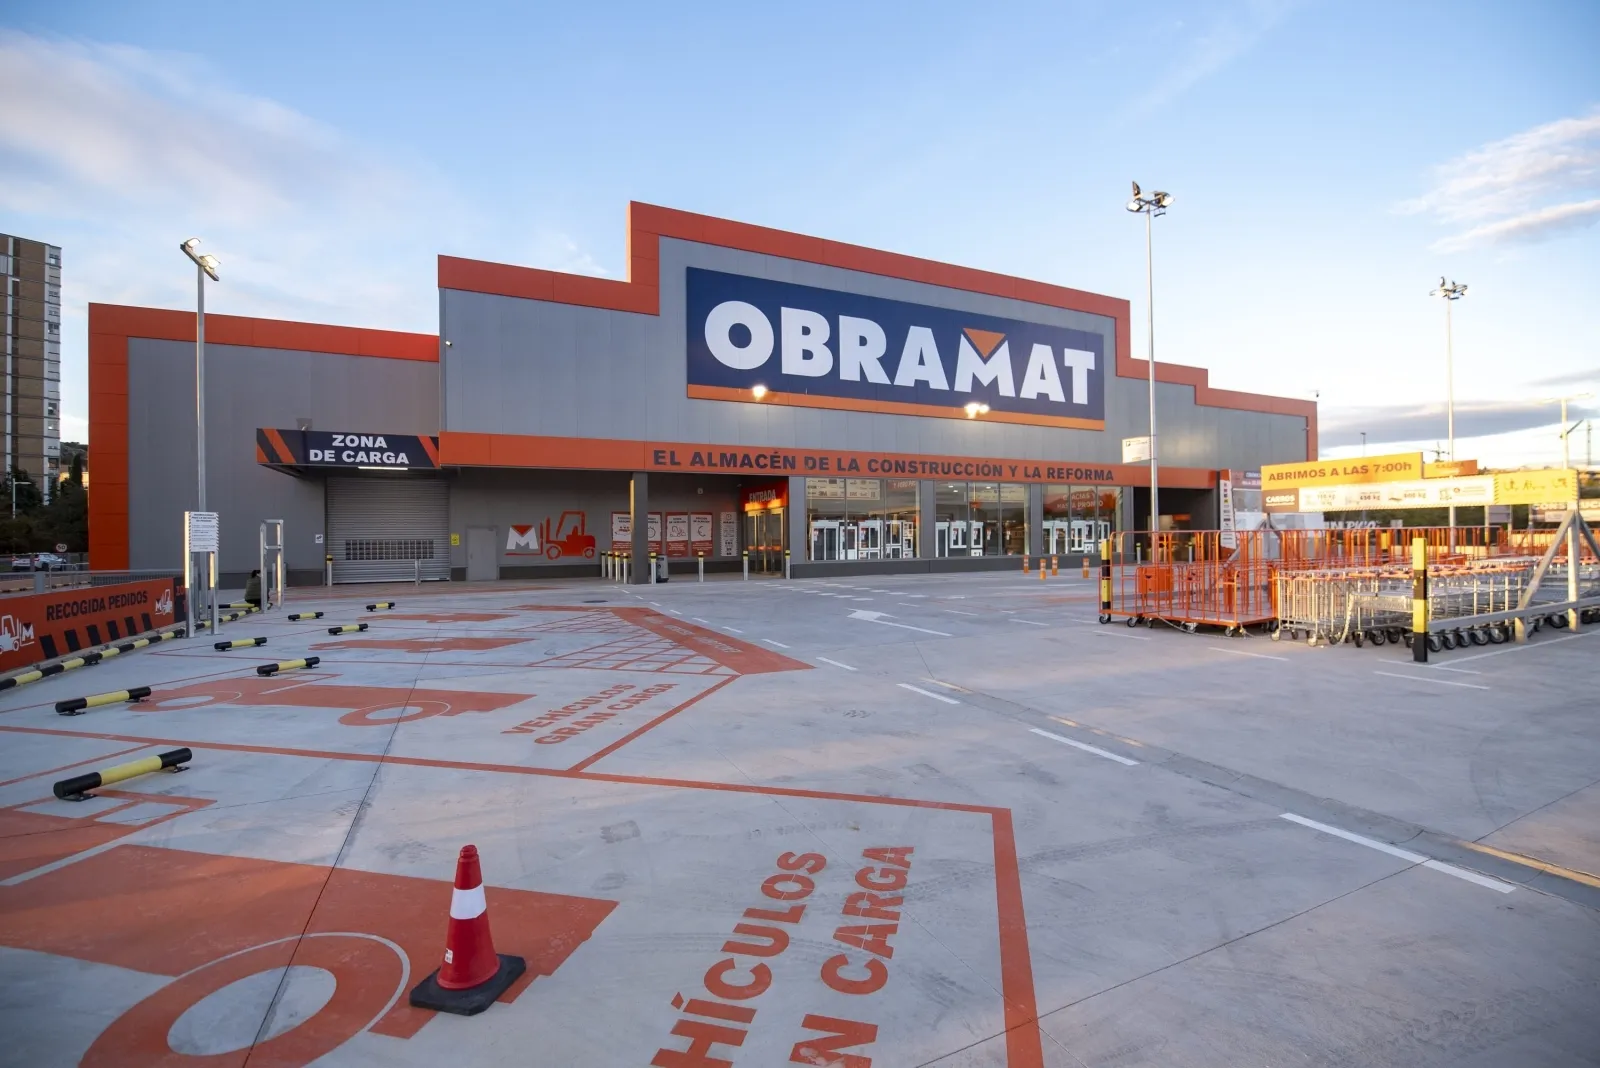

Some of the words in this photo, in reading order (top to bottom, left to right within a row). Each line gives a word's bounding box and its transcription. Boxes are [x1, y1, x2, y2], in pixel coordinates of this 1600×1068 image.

[704, 300, 1096, 405] OBRAMAT
[309, 449, 336, 462] DE
[341, 450, 410, 464] CARGA
[332, 434, 387, 449] ZONA
[653, 449, 681, 466] EL
[689, 451, 796, 470] ALMACÉN
[804, 456, 830, 471] DE
[836, 457, 861, 472] LA
[867, 458, 1003, 477] CONSTRUCCIÓN
[1008, 466, 1018, 477] Y
[1023, 467, 1042, 478] LA
[1047, 467, 1114, 481] REFORMA
[1268, 468, 1326, 482] ABRIMOS
[1330, 467, 1340, 477] A
[1343, 464, 1369, 476] LAS
[1373, 461, 1412, 473] 7:00h
[1057, 502, 1076, 510] HASA
[1077, 500, 1104, 510] PRONO
[1062, 492, 1091, 501] GACIAS
[46, 597, 107, 621] RECOGIDA
[108, 590, 149, 611] PEDIDOS
[500, 683, 637, 735] VEHÍCULOS
[534, 711, 618, 745] GRAN
[606, 683, 680, 711] CARGA
[820, 846, 915, 996] CARGA
